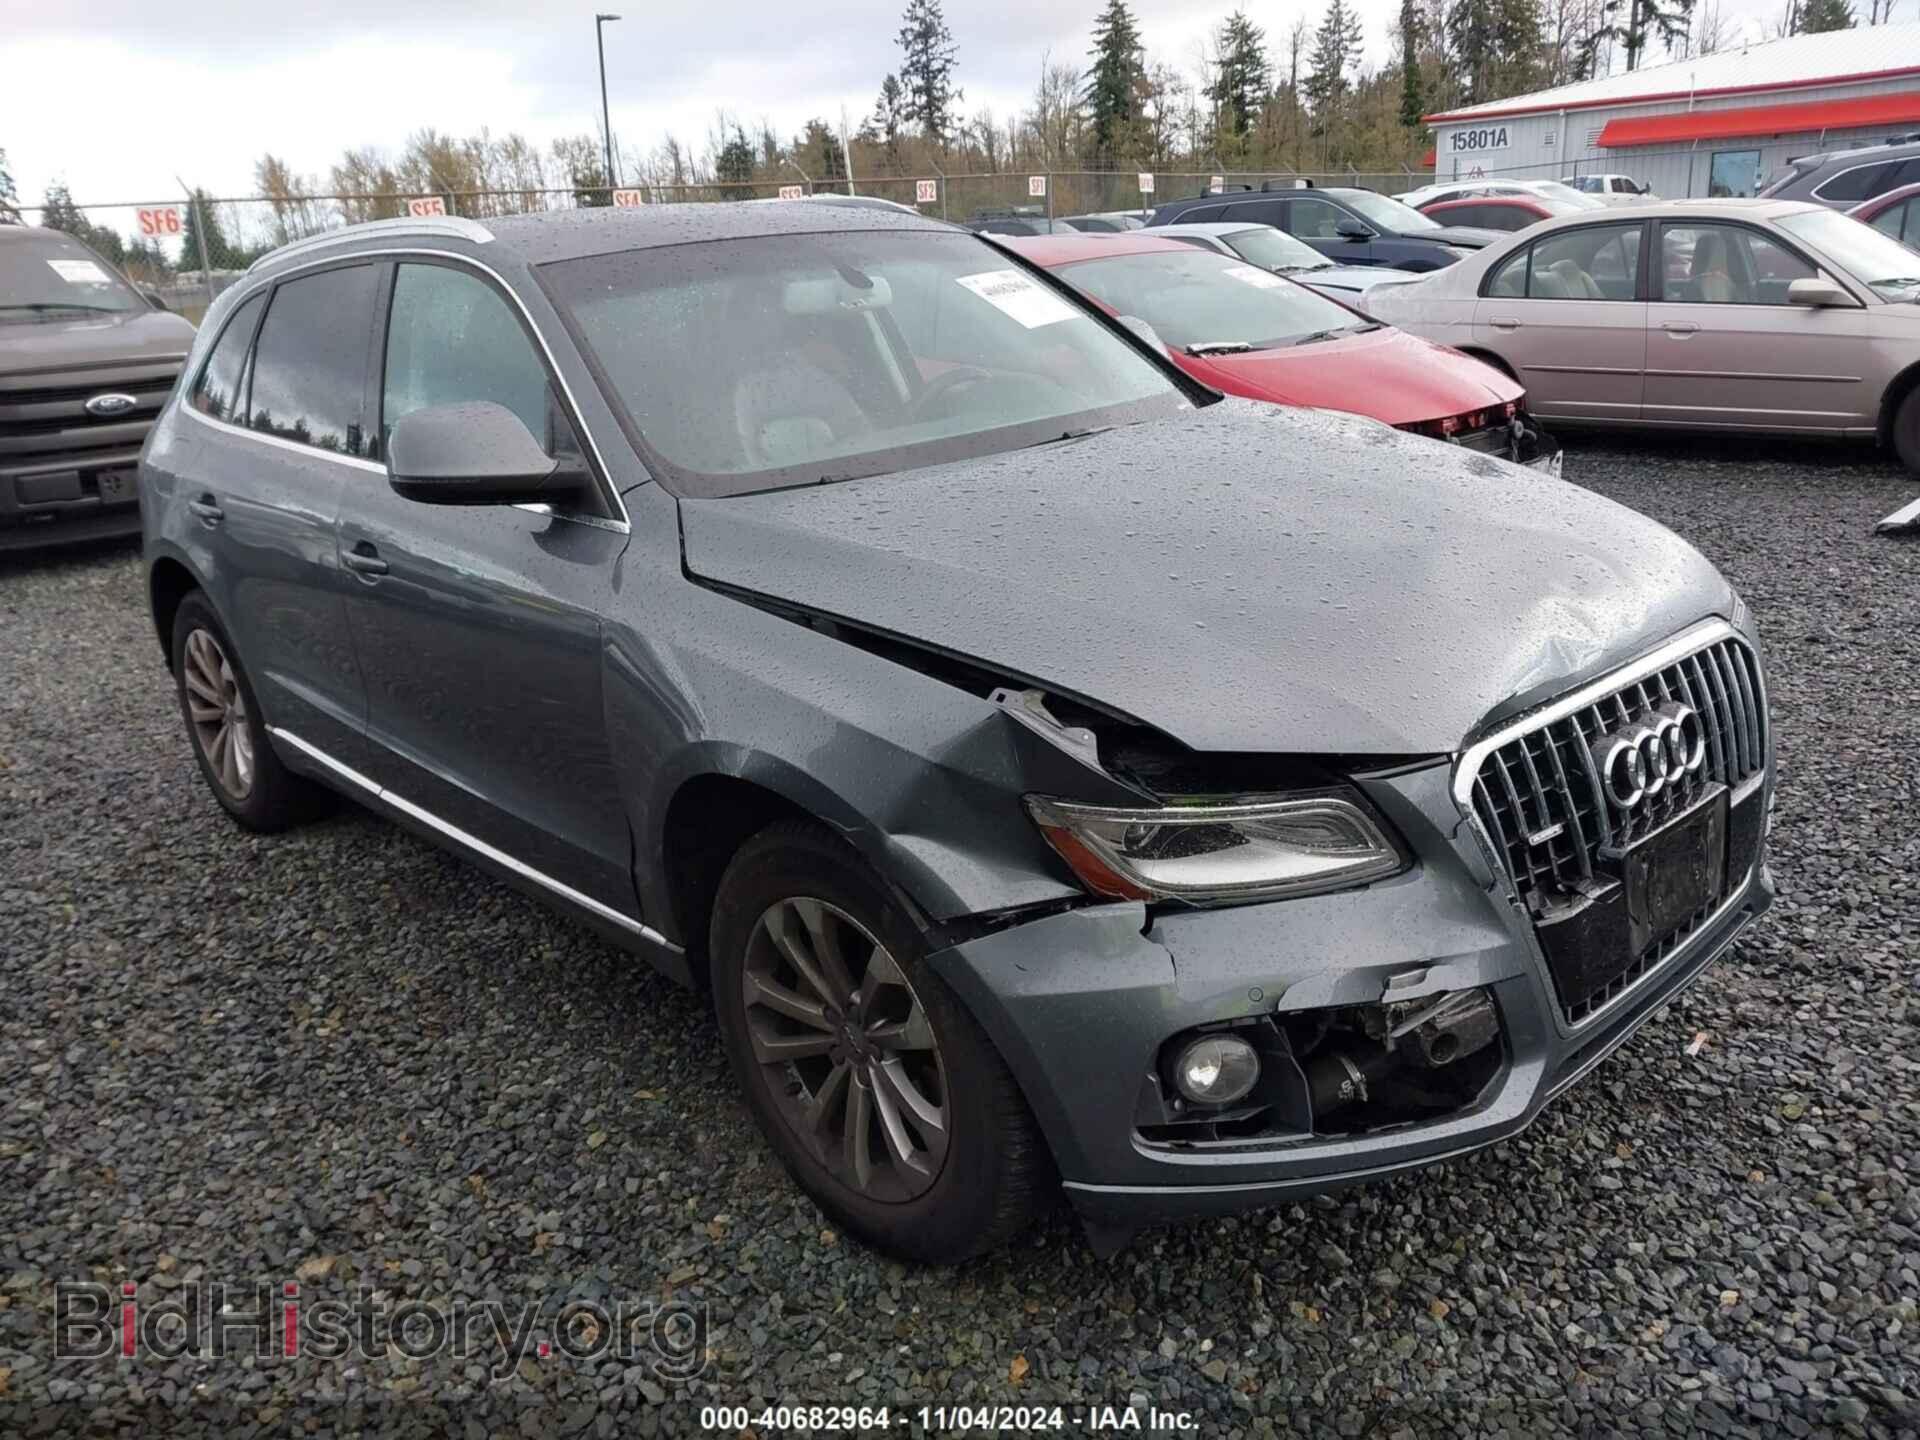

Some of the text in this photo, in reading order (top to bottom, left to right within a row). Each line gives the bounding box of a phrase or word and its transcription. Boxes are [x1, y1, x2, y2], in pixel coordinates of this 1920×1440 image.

[1450, 127, 1508, 151] 15801A
[918, 181, 936, 200] SF2
[139, 208, 179, 235] SF6
